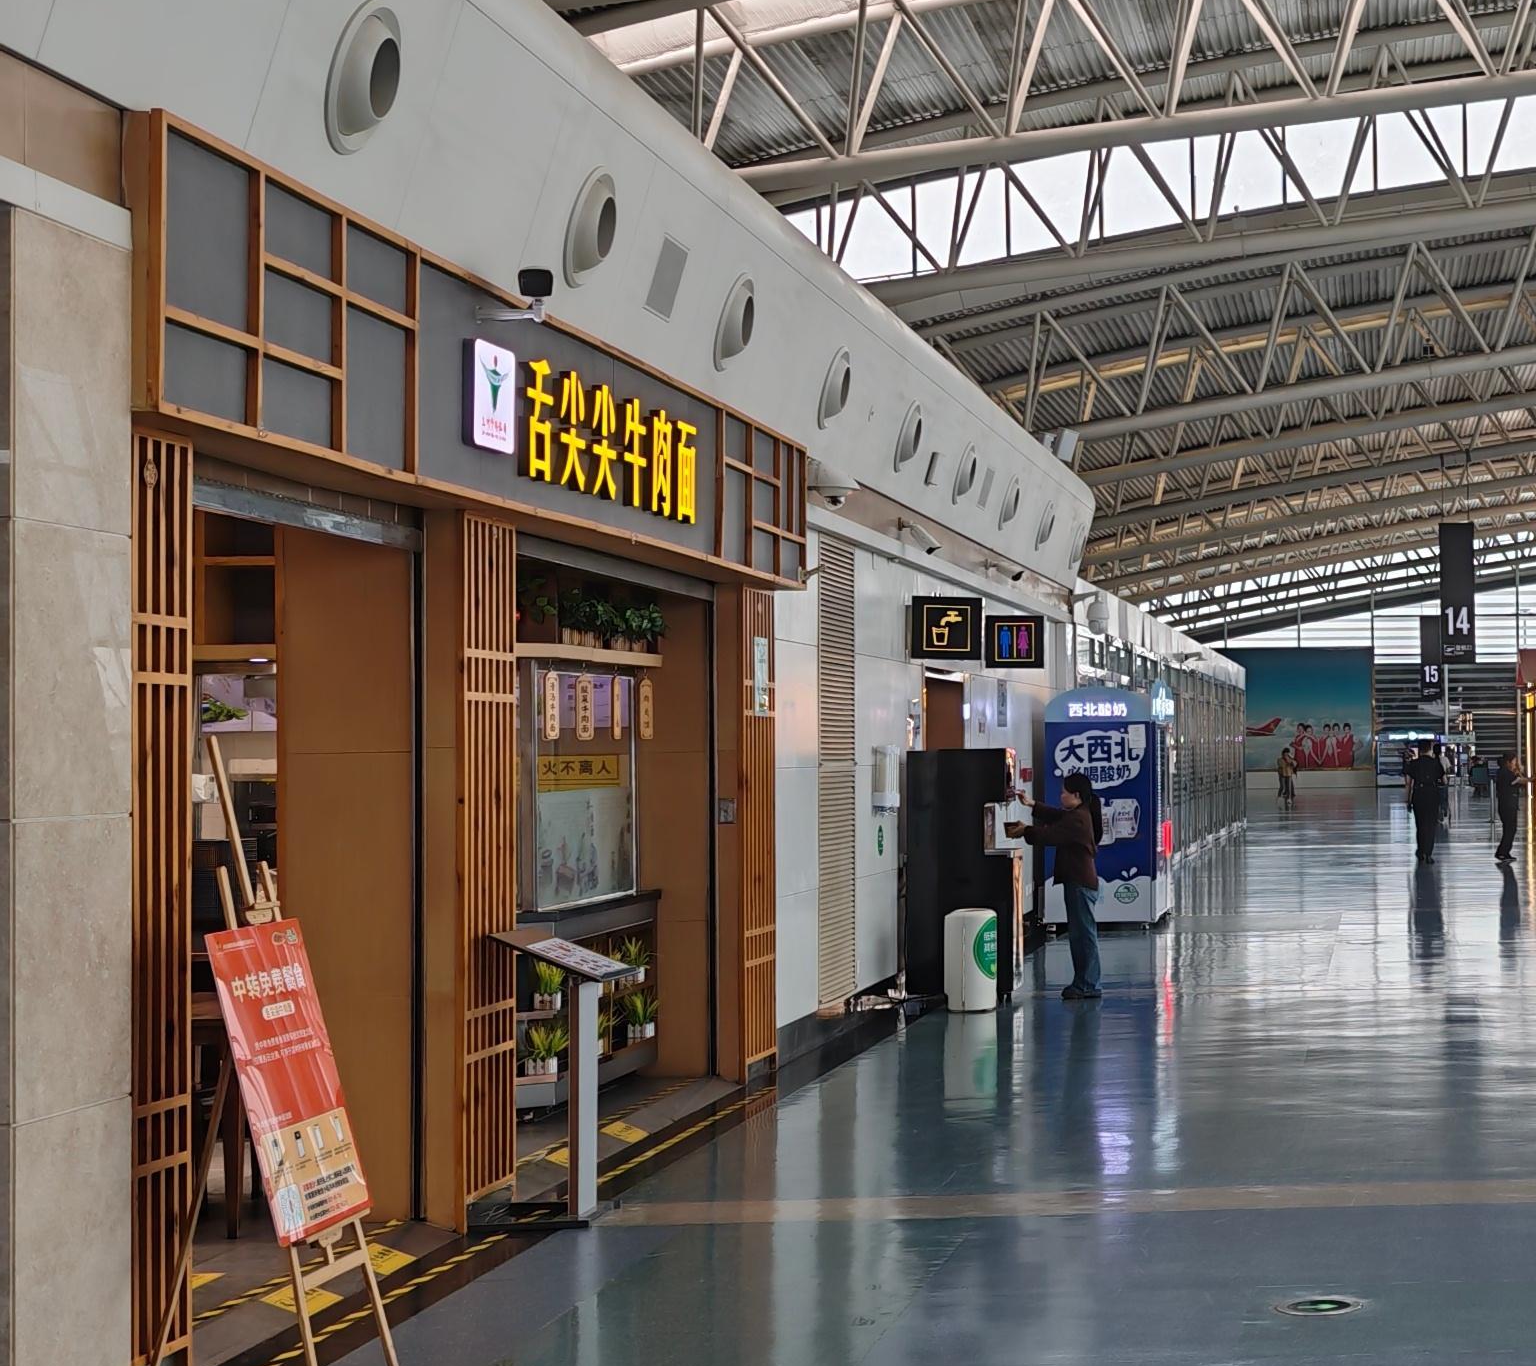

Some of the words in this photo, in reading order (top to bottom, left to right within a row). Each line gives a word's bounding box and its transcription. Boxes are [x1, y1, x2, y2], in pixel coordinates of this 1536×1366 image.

[526, 359, 698, 525] 舌尖尖牛肉面
[1444, 606, 1471, 636] 14
[1423, 665, 1439, 683] 15
[1067, 701, 1128, 718] 西北酸奶
[1060, 735, 1141, 764] 大西北
[542, 760, 612, 776] 火不离人
[230, 962, 307, 1004] 中转免费餐食
